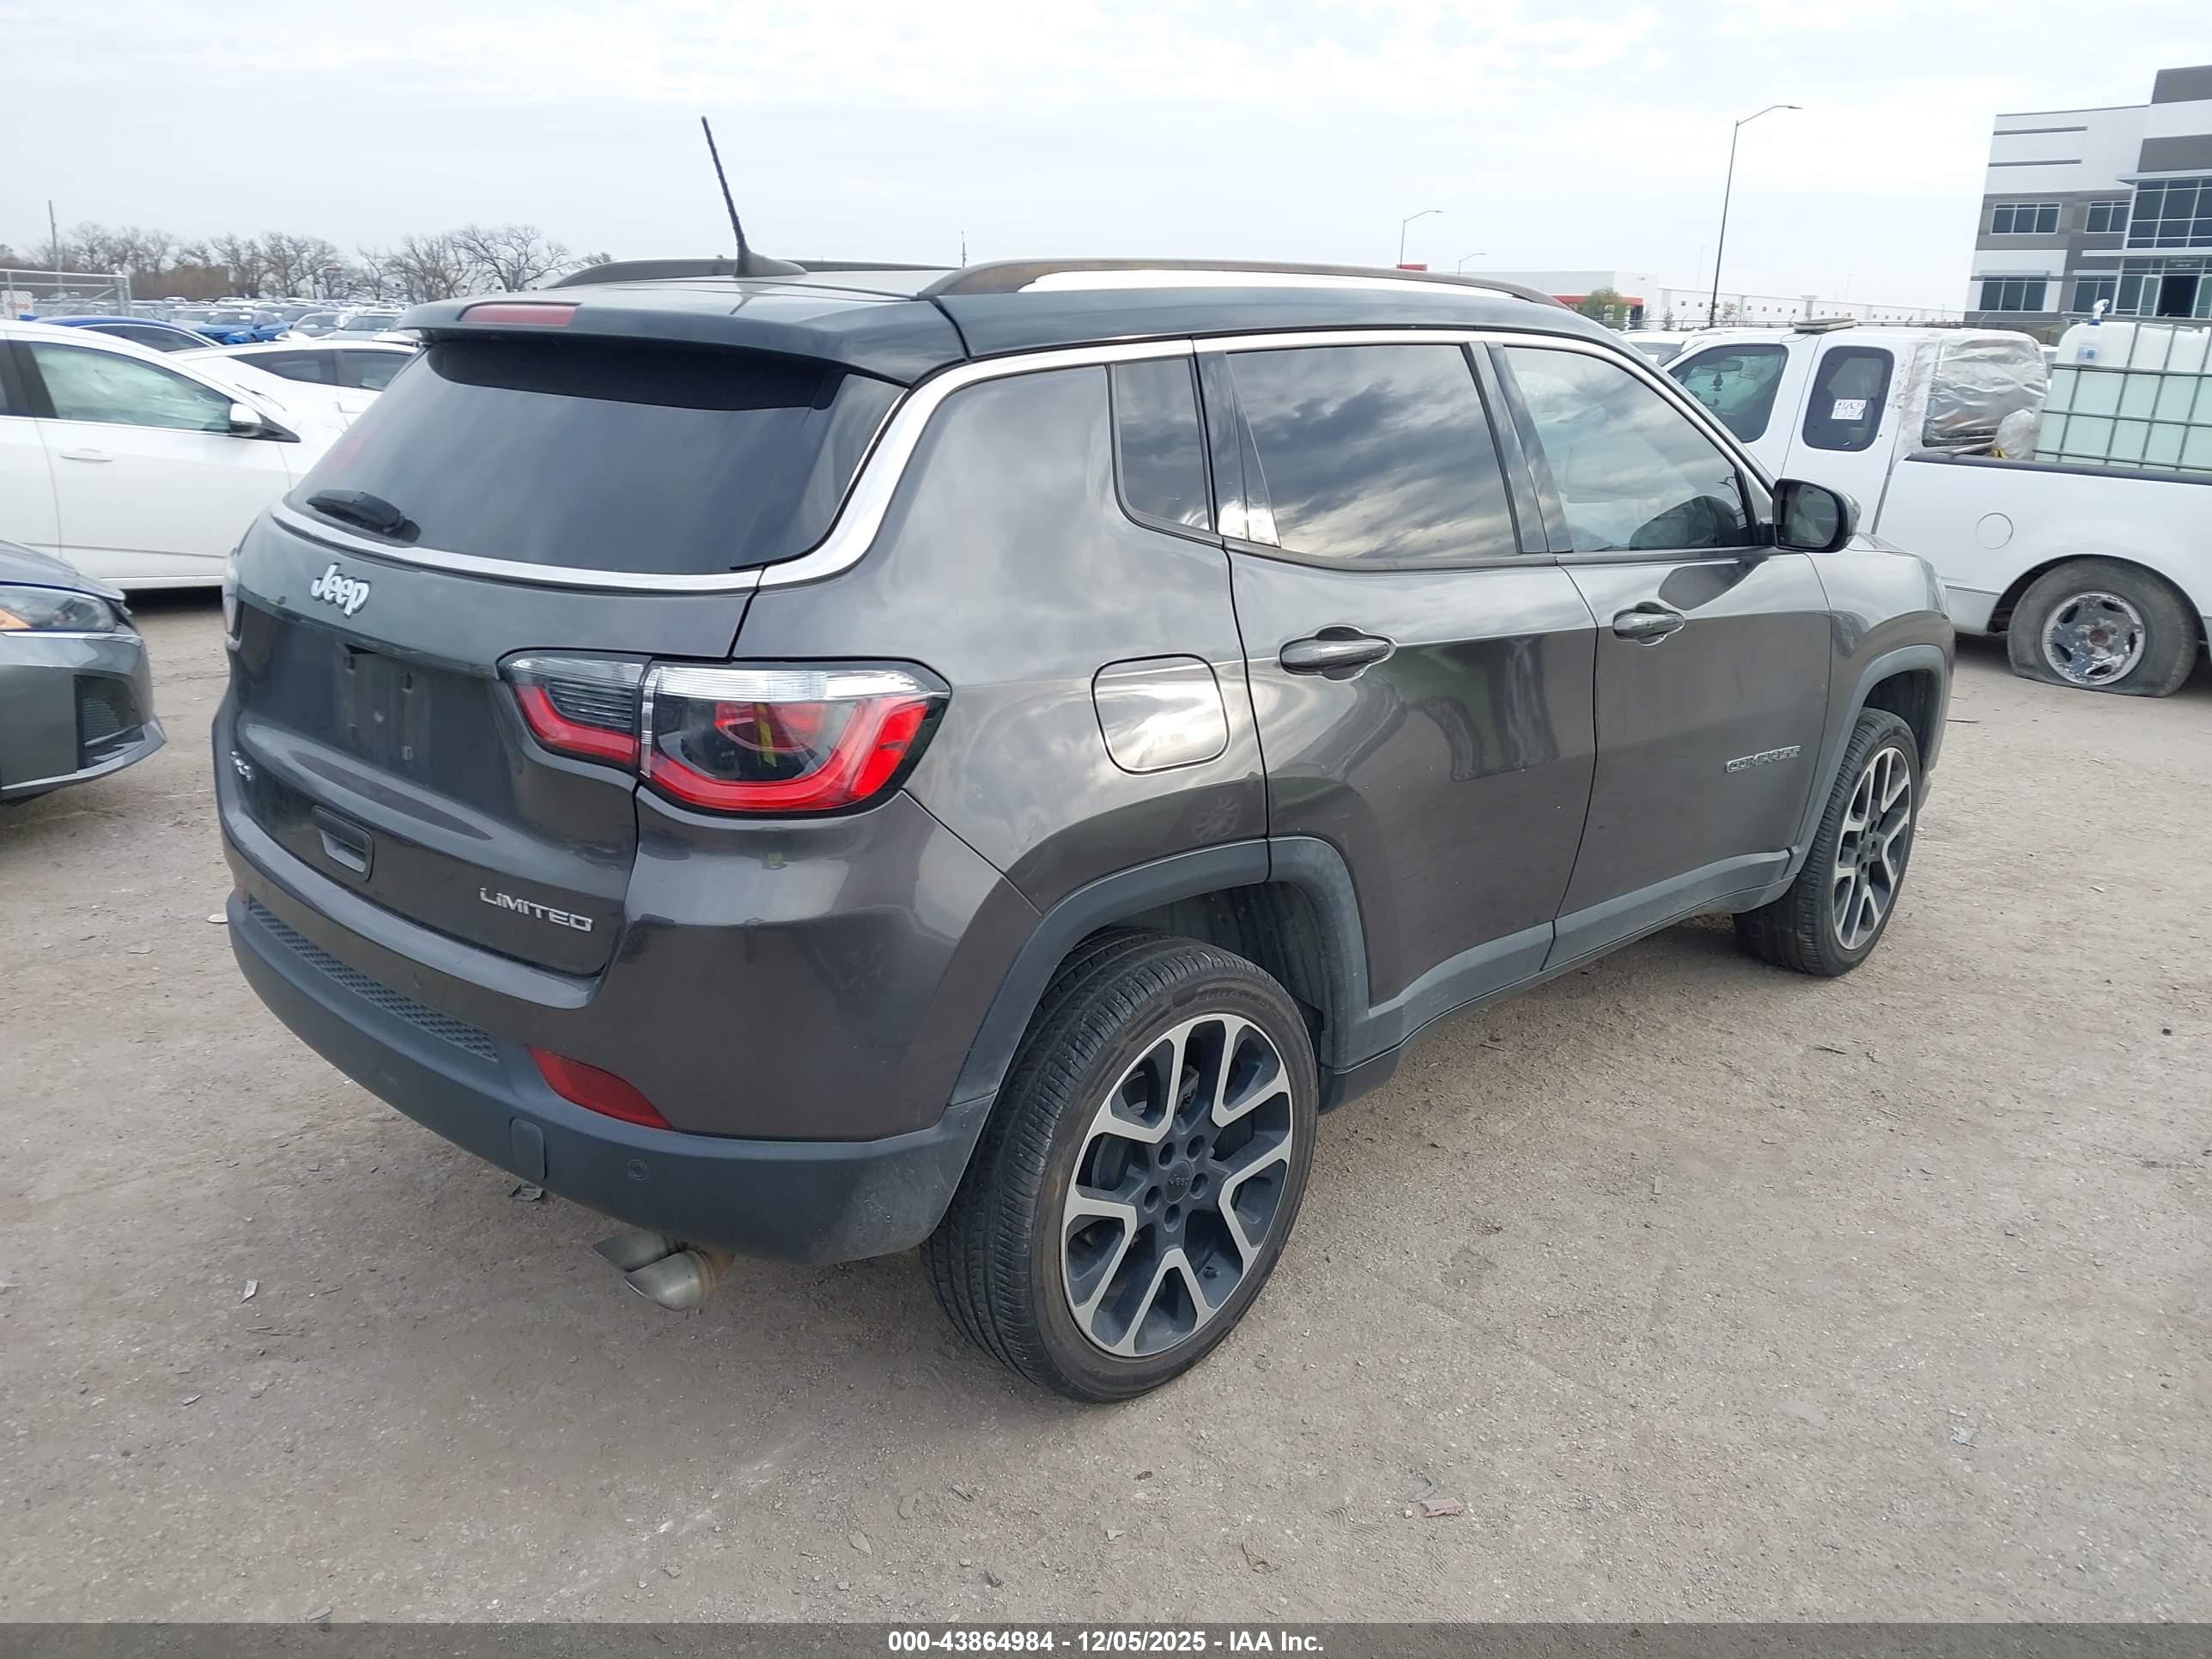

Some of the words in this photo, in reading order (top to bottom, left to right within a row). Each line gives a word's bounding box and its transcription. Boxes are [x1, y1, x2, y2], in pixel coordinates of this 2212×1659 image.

[310, 562, 370, 618] Jeep
[1726, 744, 1802, 773] COMPASS
[479, 887, 594, 933] LIMITED
